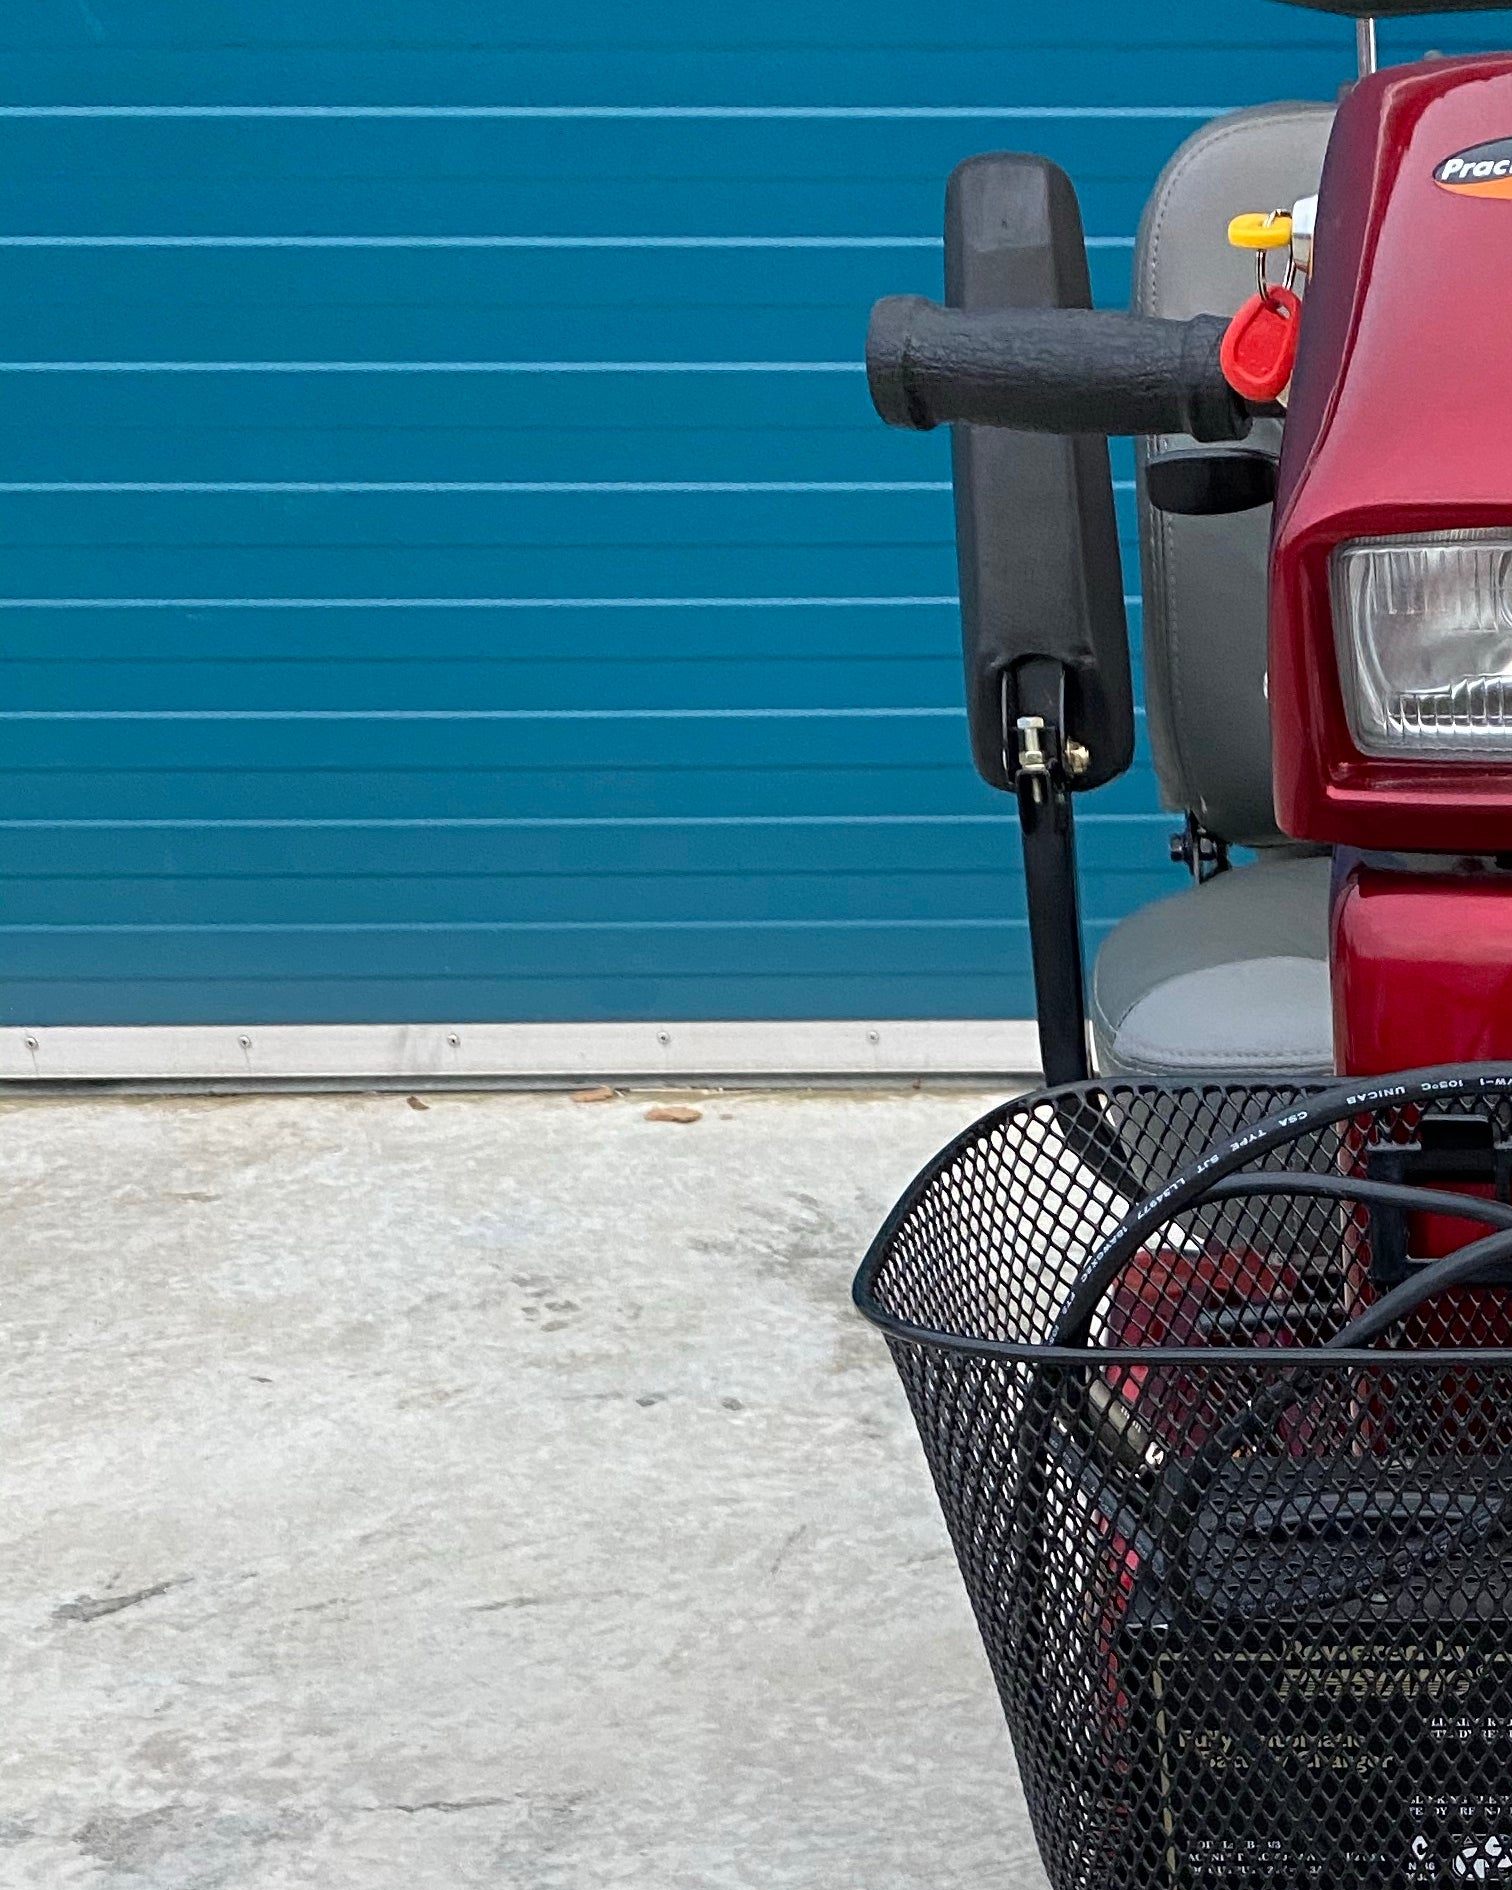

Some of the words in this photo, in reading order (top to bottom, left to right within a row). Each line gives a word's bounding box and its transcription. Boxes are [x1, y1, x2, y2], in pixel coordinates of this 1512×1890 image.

[1346, 1085, 1406, 1105] UNICAB
[1278, 1111, 1309, 1128] CSA
[1229, 1129, 1267, 1152] TYPE
